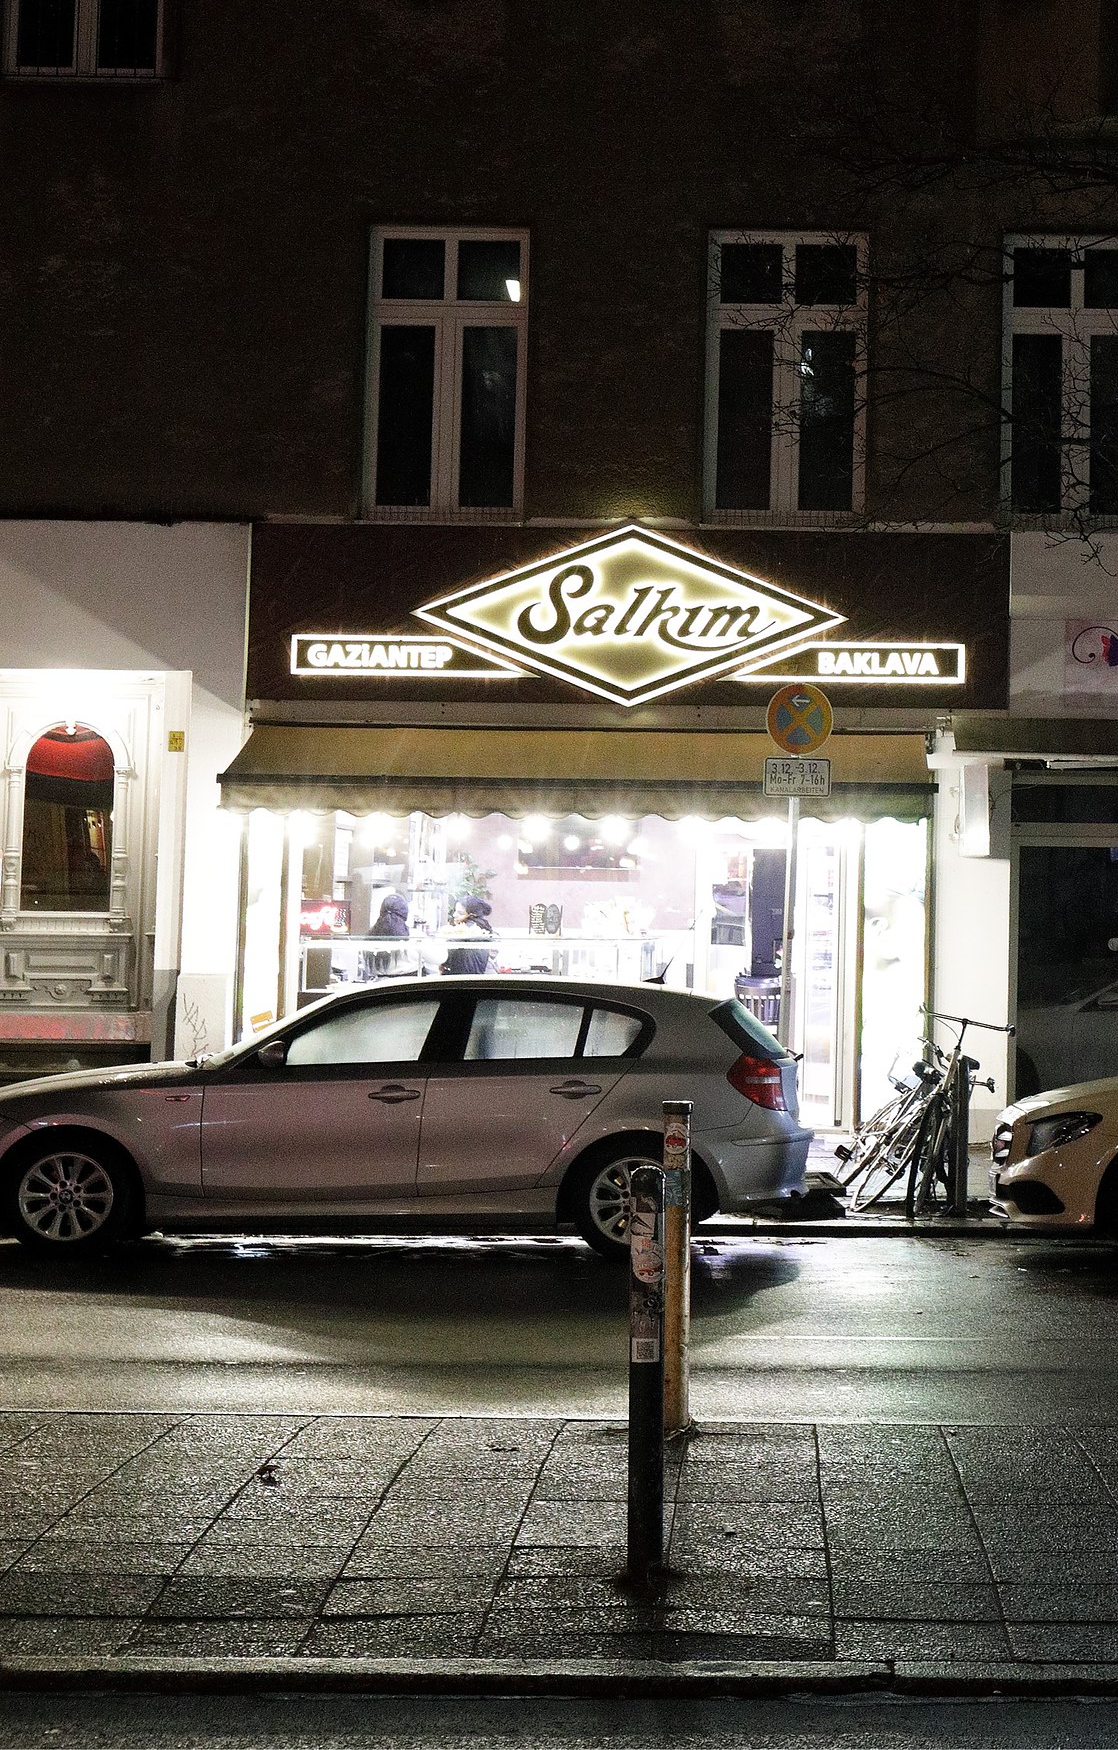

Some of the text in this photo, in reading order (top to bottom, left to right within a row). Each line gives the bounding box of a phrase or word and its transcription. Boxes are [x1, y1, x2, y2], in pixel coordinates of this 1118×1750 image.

[517, 564, 777, 652] Salkım
[817, 651, 939, 676] BAKLAVA
[769, 773, 796, 785] Mo-Fr
